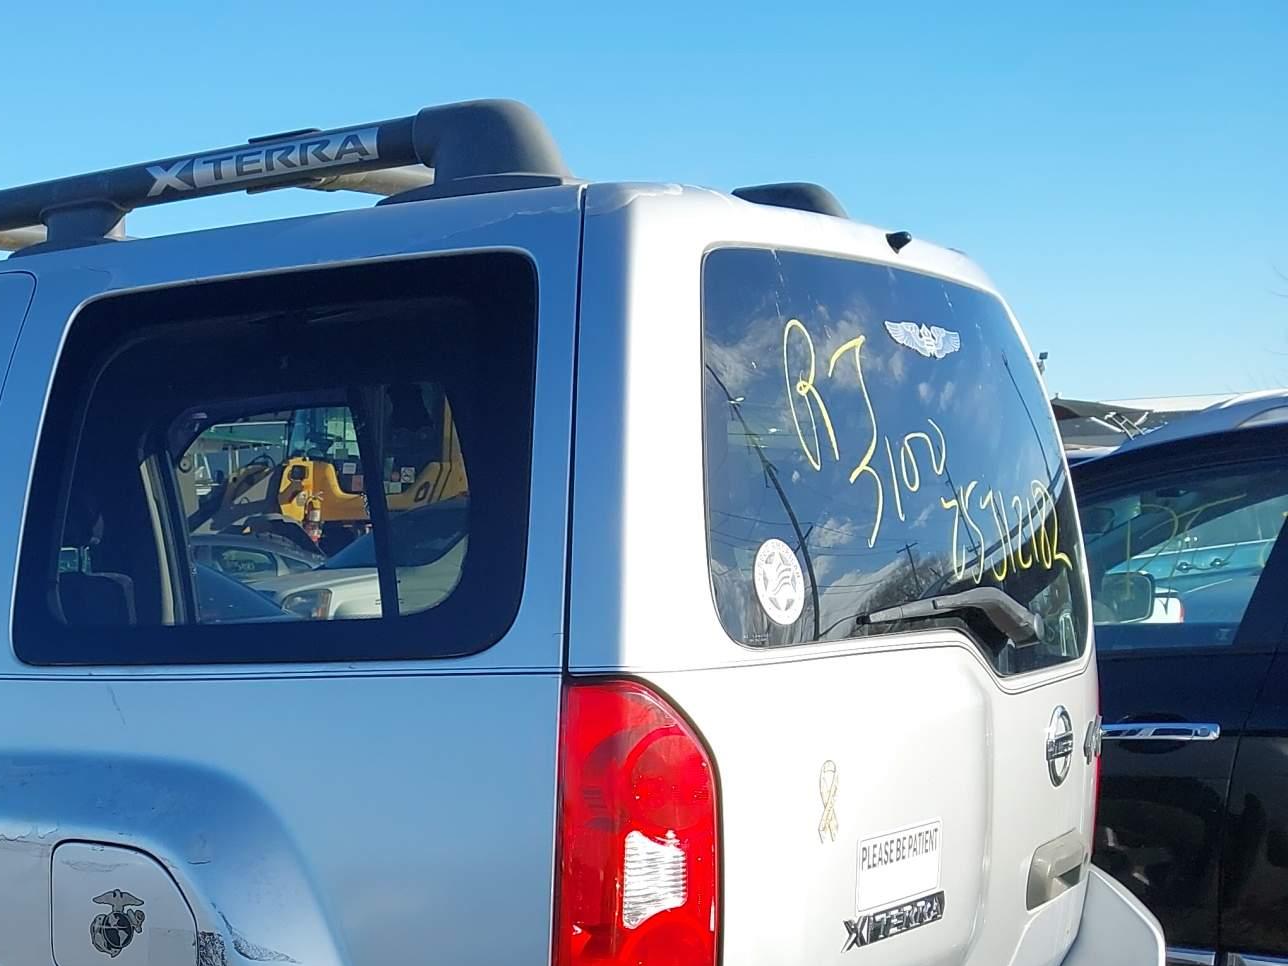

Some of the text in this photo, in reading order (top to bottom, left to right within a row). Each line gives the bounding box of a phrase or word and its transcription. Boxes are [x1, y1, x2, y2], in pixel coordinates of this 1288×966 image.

[145, 133, 371, 198] XTERRA
[861, 827, 939, 871] PLEASE BE PATIENT
[841, 891, 944, 953] XTERRA
